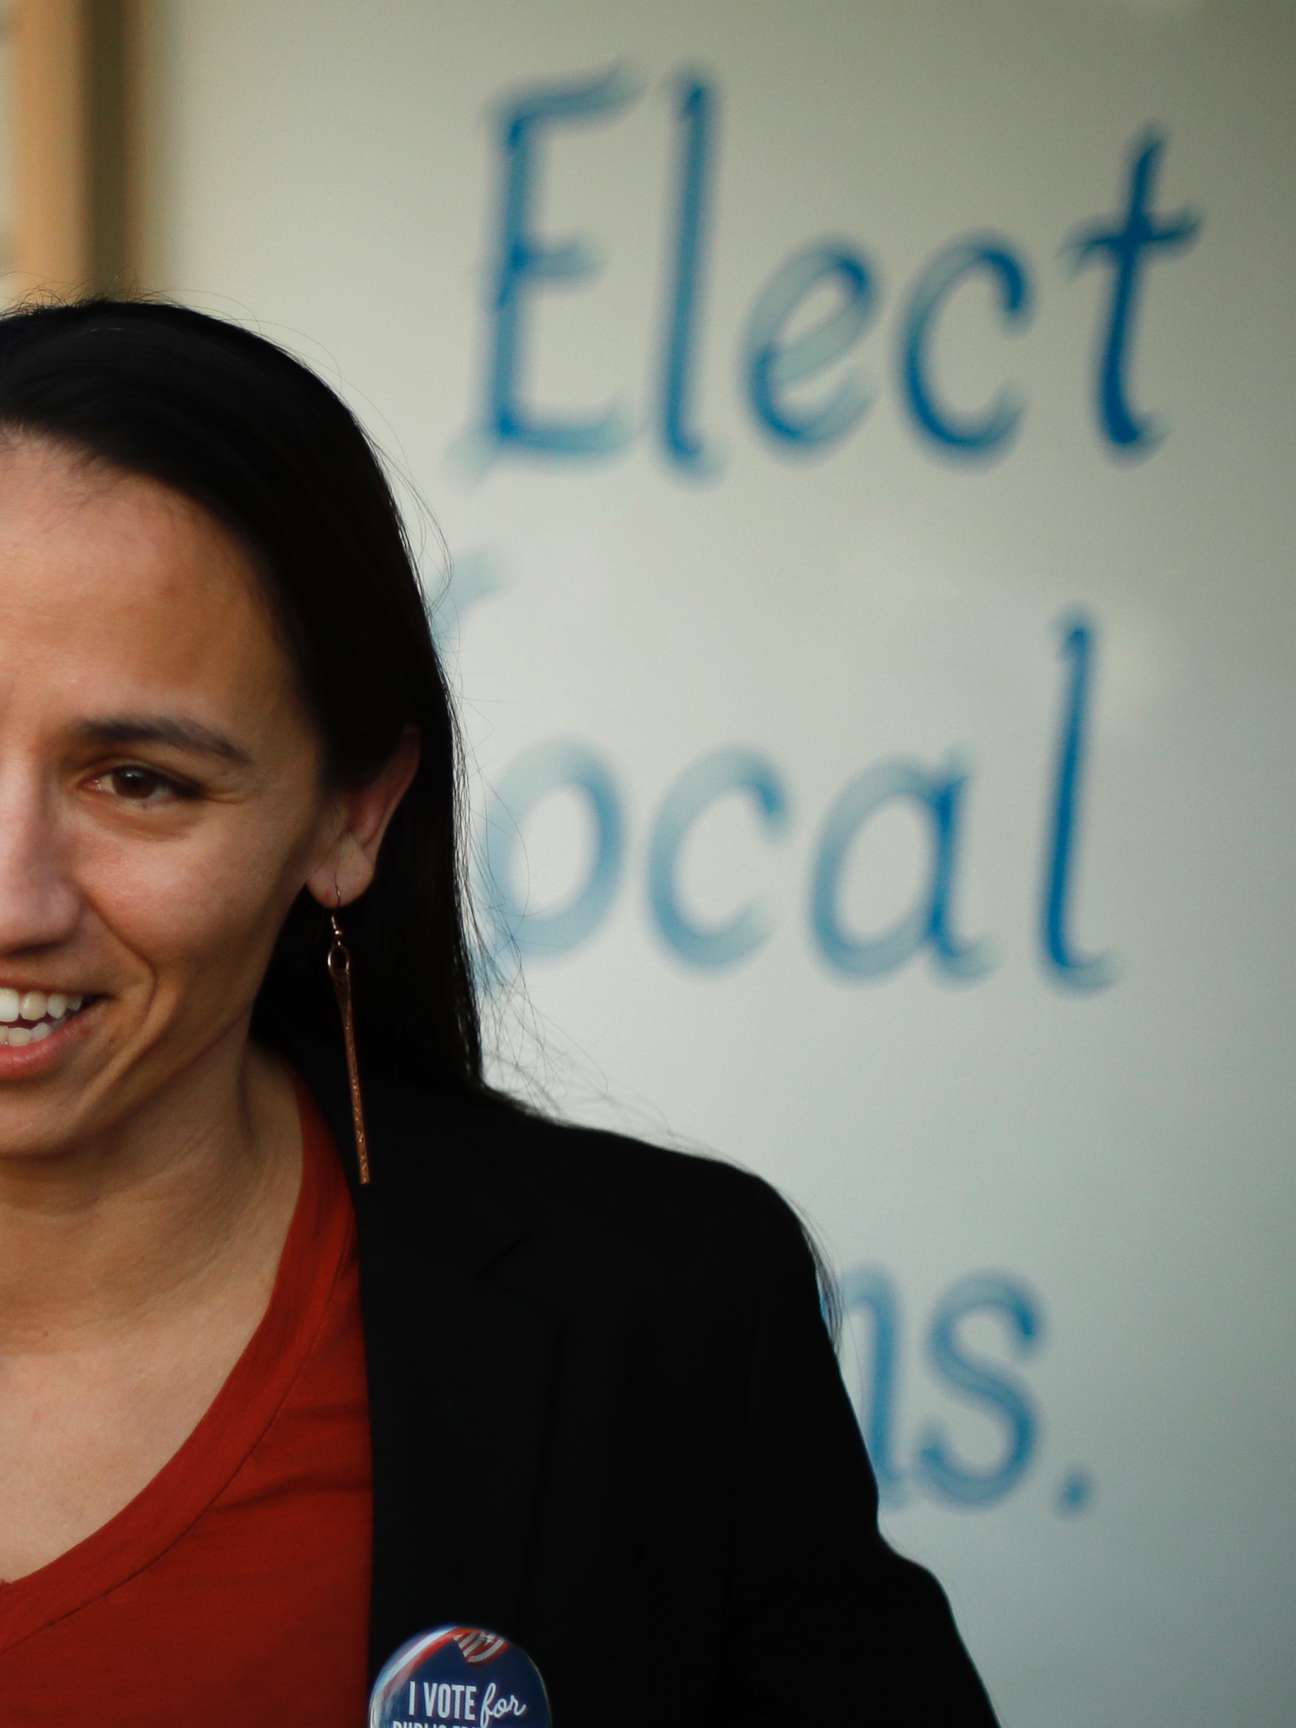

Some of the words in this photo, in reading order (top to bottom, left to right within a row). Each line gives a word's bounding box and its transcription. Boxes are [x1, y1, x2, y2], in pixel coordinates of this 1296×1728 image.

[449, 58, 1200, 485] Elect
[428, 550, 1116, 995] ocal
[408, 1680, 416, 1716] I
[423, 1681, 477, 1720] VOTE
[479, 1682, 527, 1728] for
